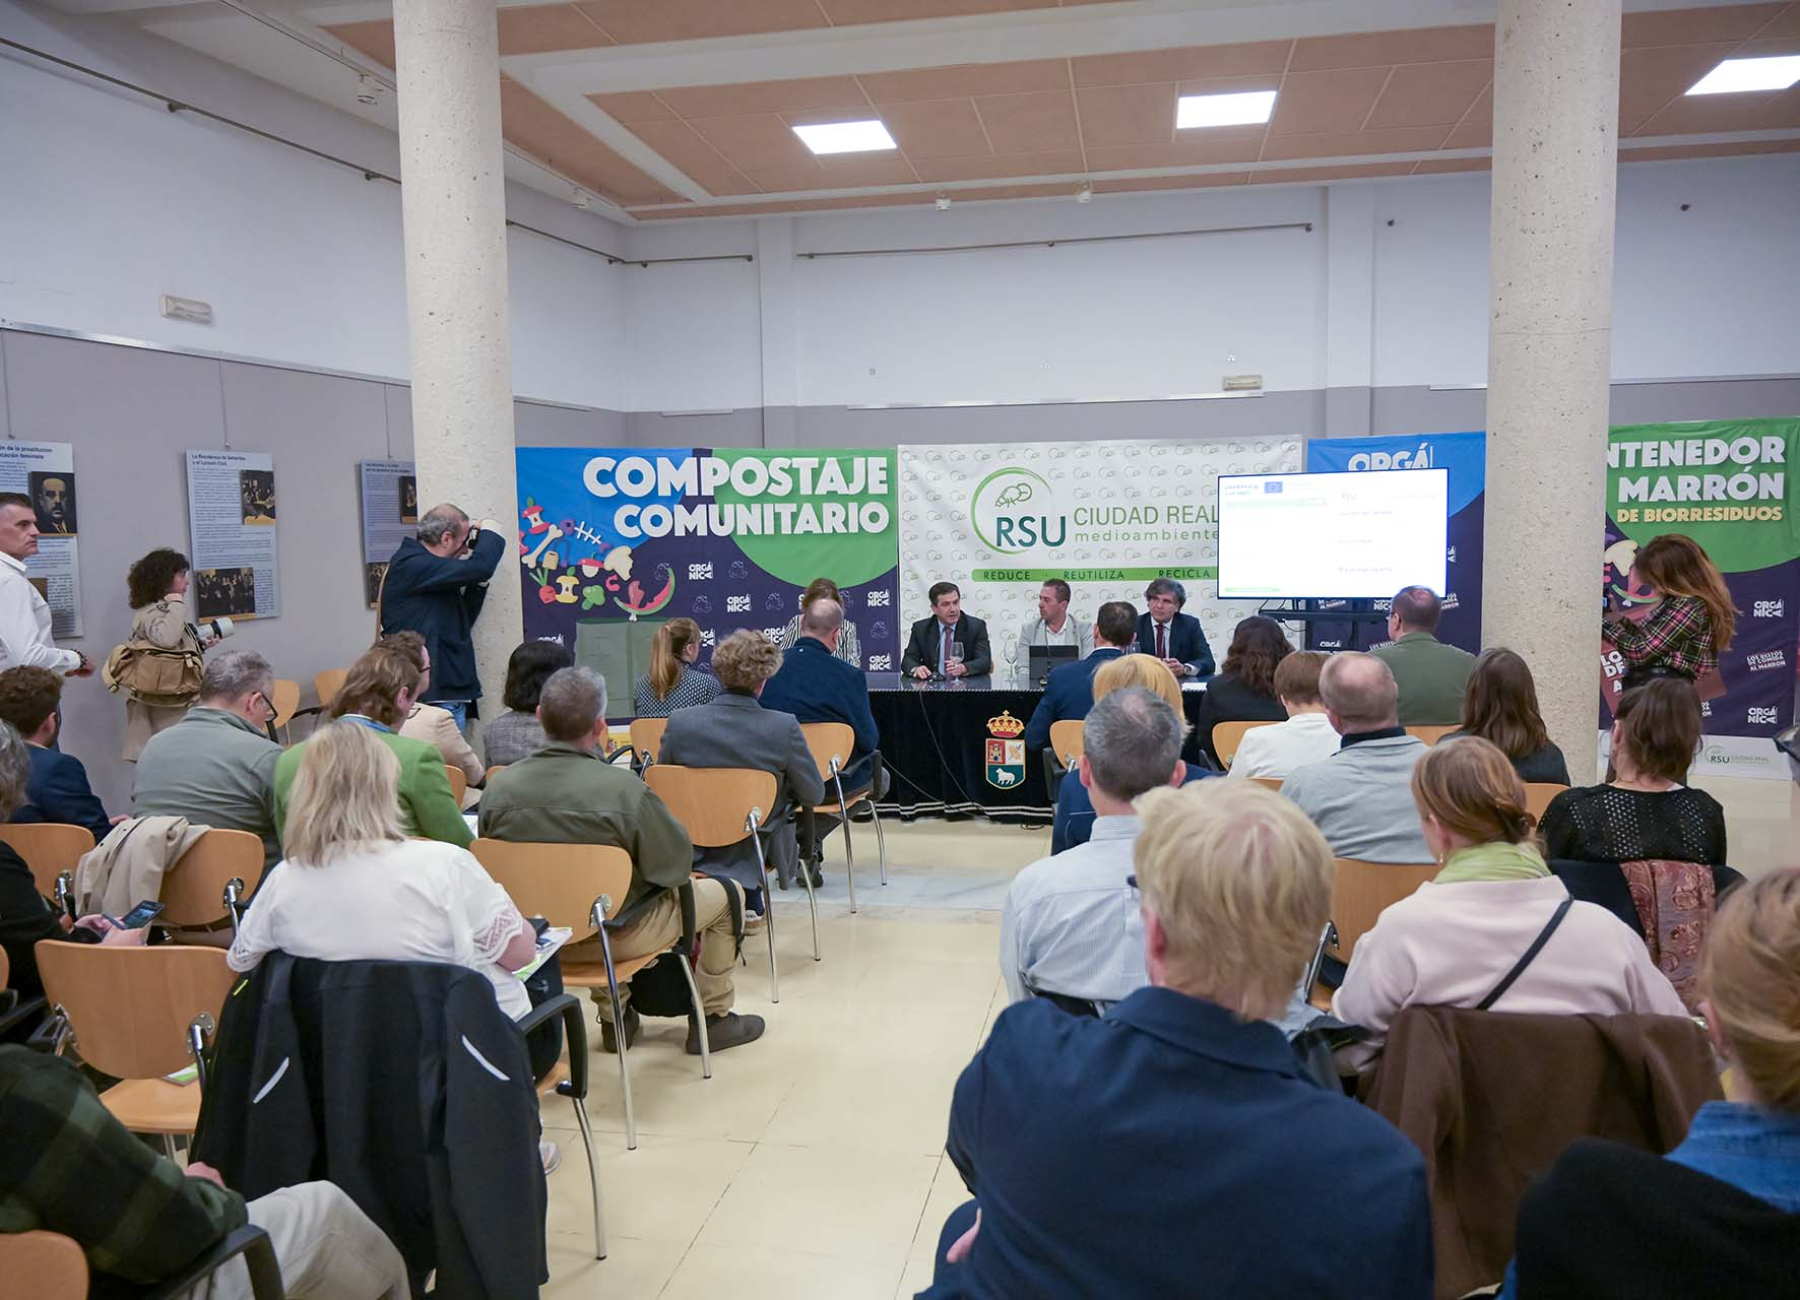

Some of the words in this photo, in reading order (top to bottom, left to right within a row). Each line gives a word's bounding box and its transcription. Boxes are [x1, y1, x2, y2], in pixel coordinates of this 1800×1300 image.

[1607, 436, 1786, 468] NTENEDOR
[583, 456, 888, 498] COMPOSTAJE
[1618, 466, 1785, 503] MARRÓN
[613, 501, 889, 538] COMUNITARIO
[1074, 506, 1159, 526] CIUDAD
[1166, 505, 1218, 524] REAL
[1617, 509, 1639, 522] DE
[1644, 506, 1783, 522] BIORRESIDUOS
[996, 516, 1066, 547] RSU
[1075, 529, 1218, 543] medioambiente
[688, 561, 712, 571] ORGÁ
[983, 571, 1031, 580] REDUCE
[1063, 570, 1125, 580] REUTILIZA
[1158, 569, 1211, 579] RECICLA
[727, 593, 750, 604] ORGÁ
[1753, 599, 1782, 609] ORGÁ
[1601, 650, 1622, 667] LO
[1747, 706, 1776, 716] ORGÁ
[1710, 755, 1730, 764] RSU
